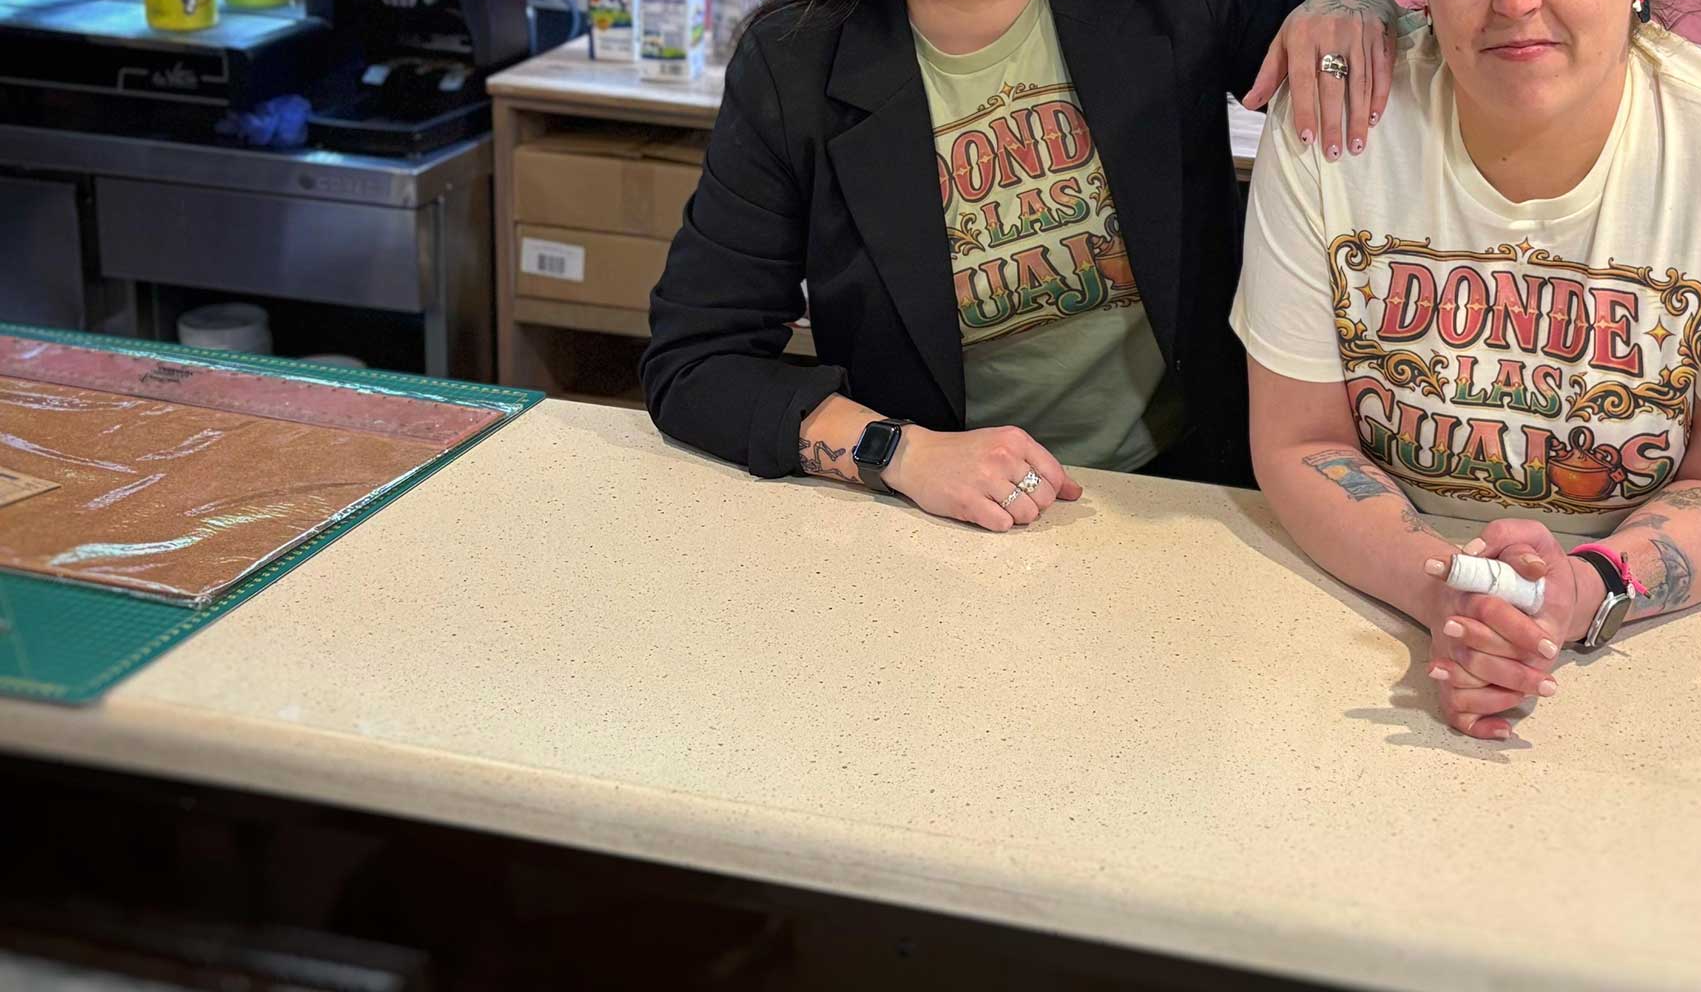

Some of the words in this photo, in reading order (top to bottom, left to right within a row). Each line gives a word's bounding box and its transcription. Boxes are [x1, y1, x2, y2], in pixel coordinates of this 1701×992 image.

[980, 176, 1092, 248] LAS
[1377, 261, 1647, 377] DONDE
[1450, 354, 1563, 419] LAS
